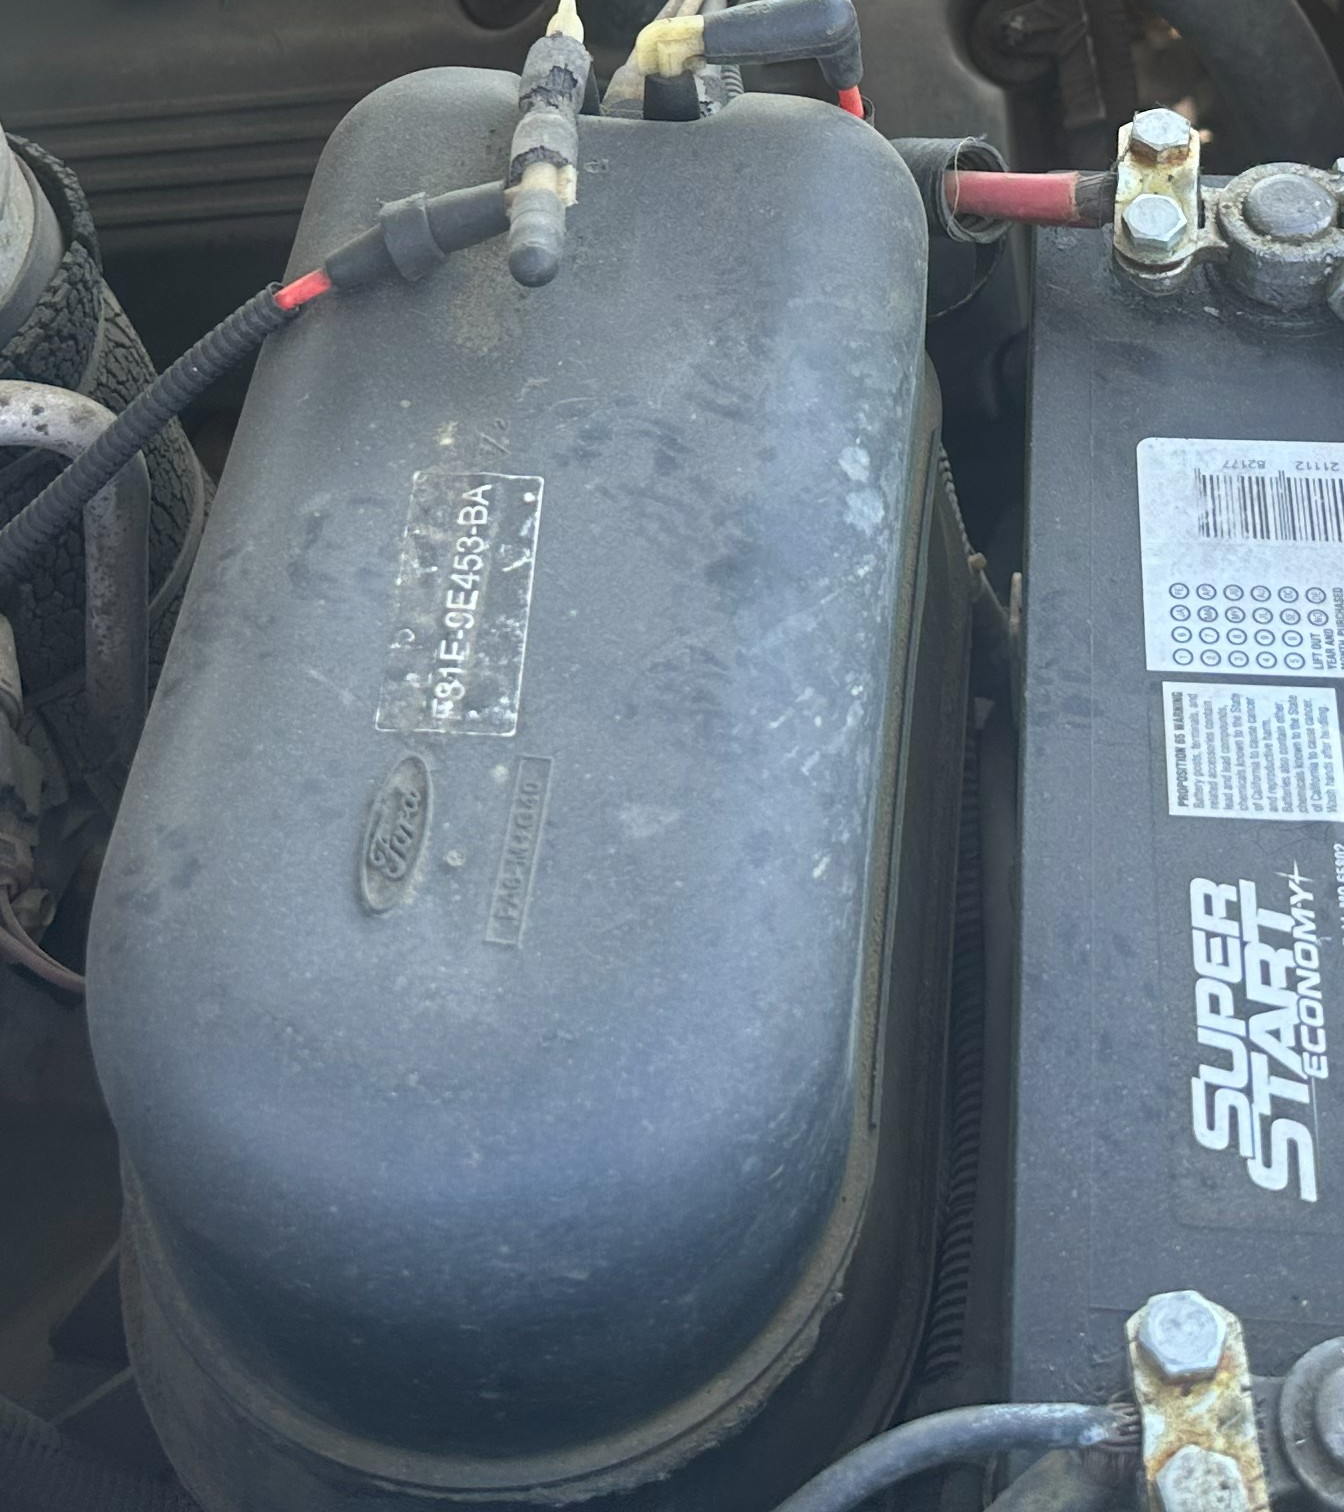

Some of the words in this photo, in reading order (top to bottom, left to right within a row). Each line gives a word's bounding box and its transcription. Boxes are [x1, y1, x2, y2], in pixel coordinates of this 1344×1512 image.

[1310, 632, 1322, 650] OUT
[1324, 628, 1335, 646] AND
[1312, 652, 1324, 670] LIFT
[1326, 648, 1337, 670] YEAR
[1172, 692, 1185, 730] WARNING
[1174, 733, 1186, 744] 65
[1175, 746, 1188, 807] PROPOSITION
[368, 789, 422, 881] Ford
[1190, 877, 1254, 1159] SUPER
[1238, 878, 1318, 1202] START
